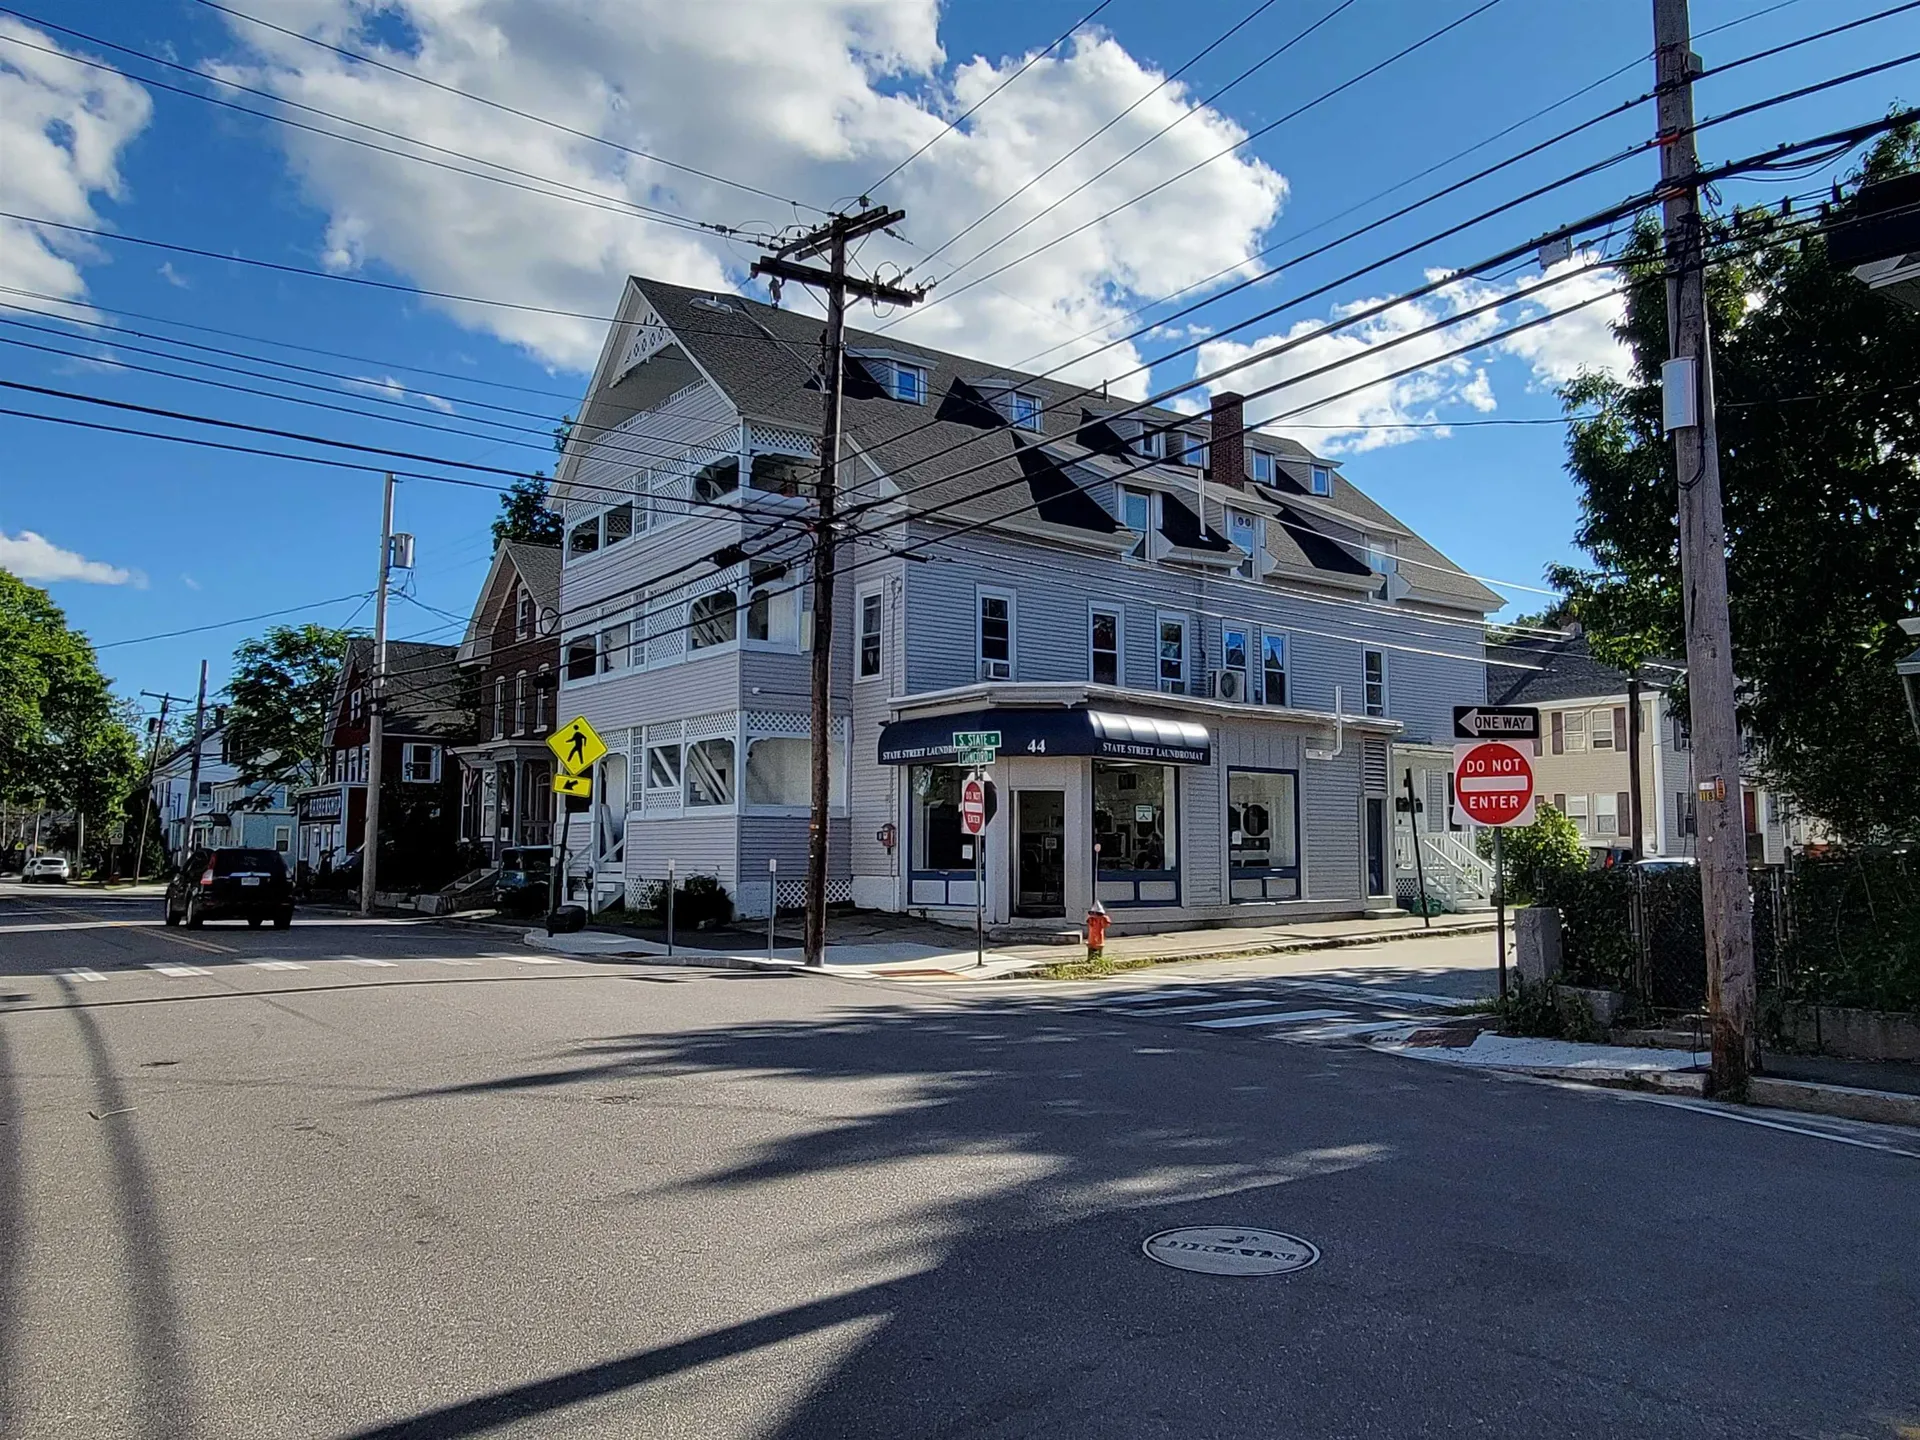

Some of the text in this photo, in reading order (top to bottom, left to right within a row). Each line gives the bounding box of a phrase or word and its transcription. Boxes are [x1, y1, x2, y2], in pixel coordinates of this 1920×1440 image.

[1474, 716, 1527, 729] ONE WAY
[968, 733, 988, 746] STATE
[1027, 739, 1046, 753] 44
[882, 744, 961, 760] STATE STREET LAUNDRO
[961, 750, 988, 763] CONCORD
[1102, 742, 1204, 761] STATE STREET LAUNDROMAT
[1466, 758, 1521, 773] DO NOT
[965, 791, 972, 800] DO
[1469, 795, 1519, 809] ENTER
